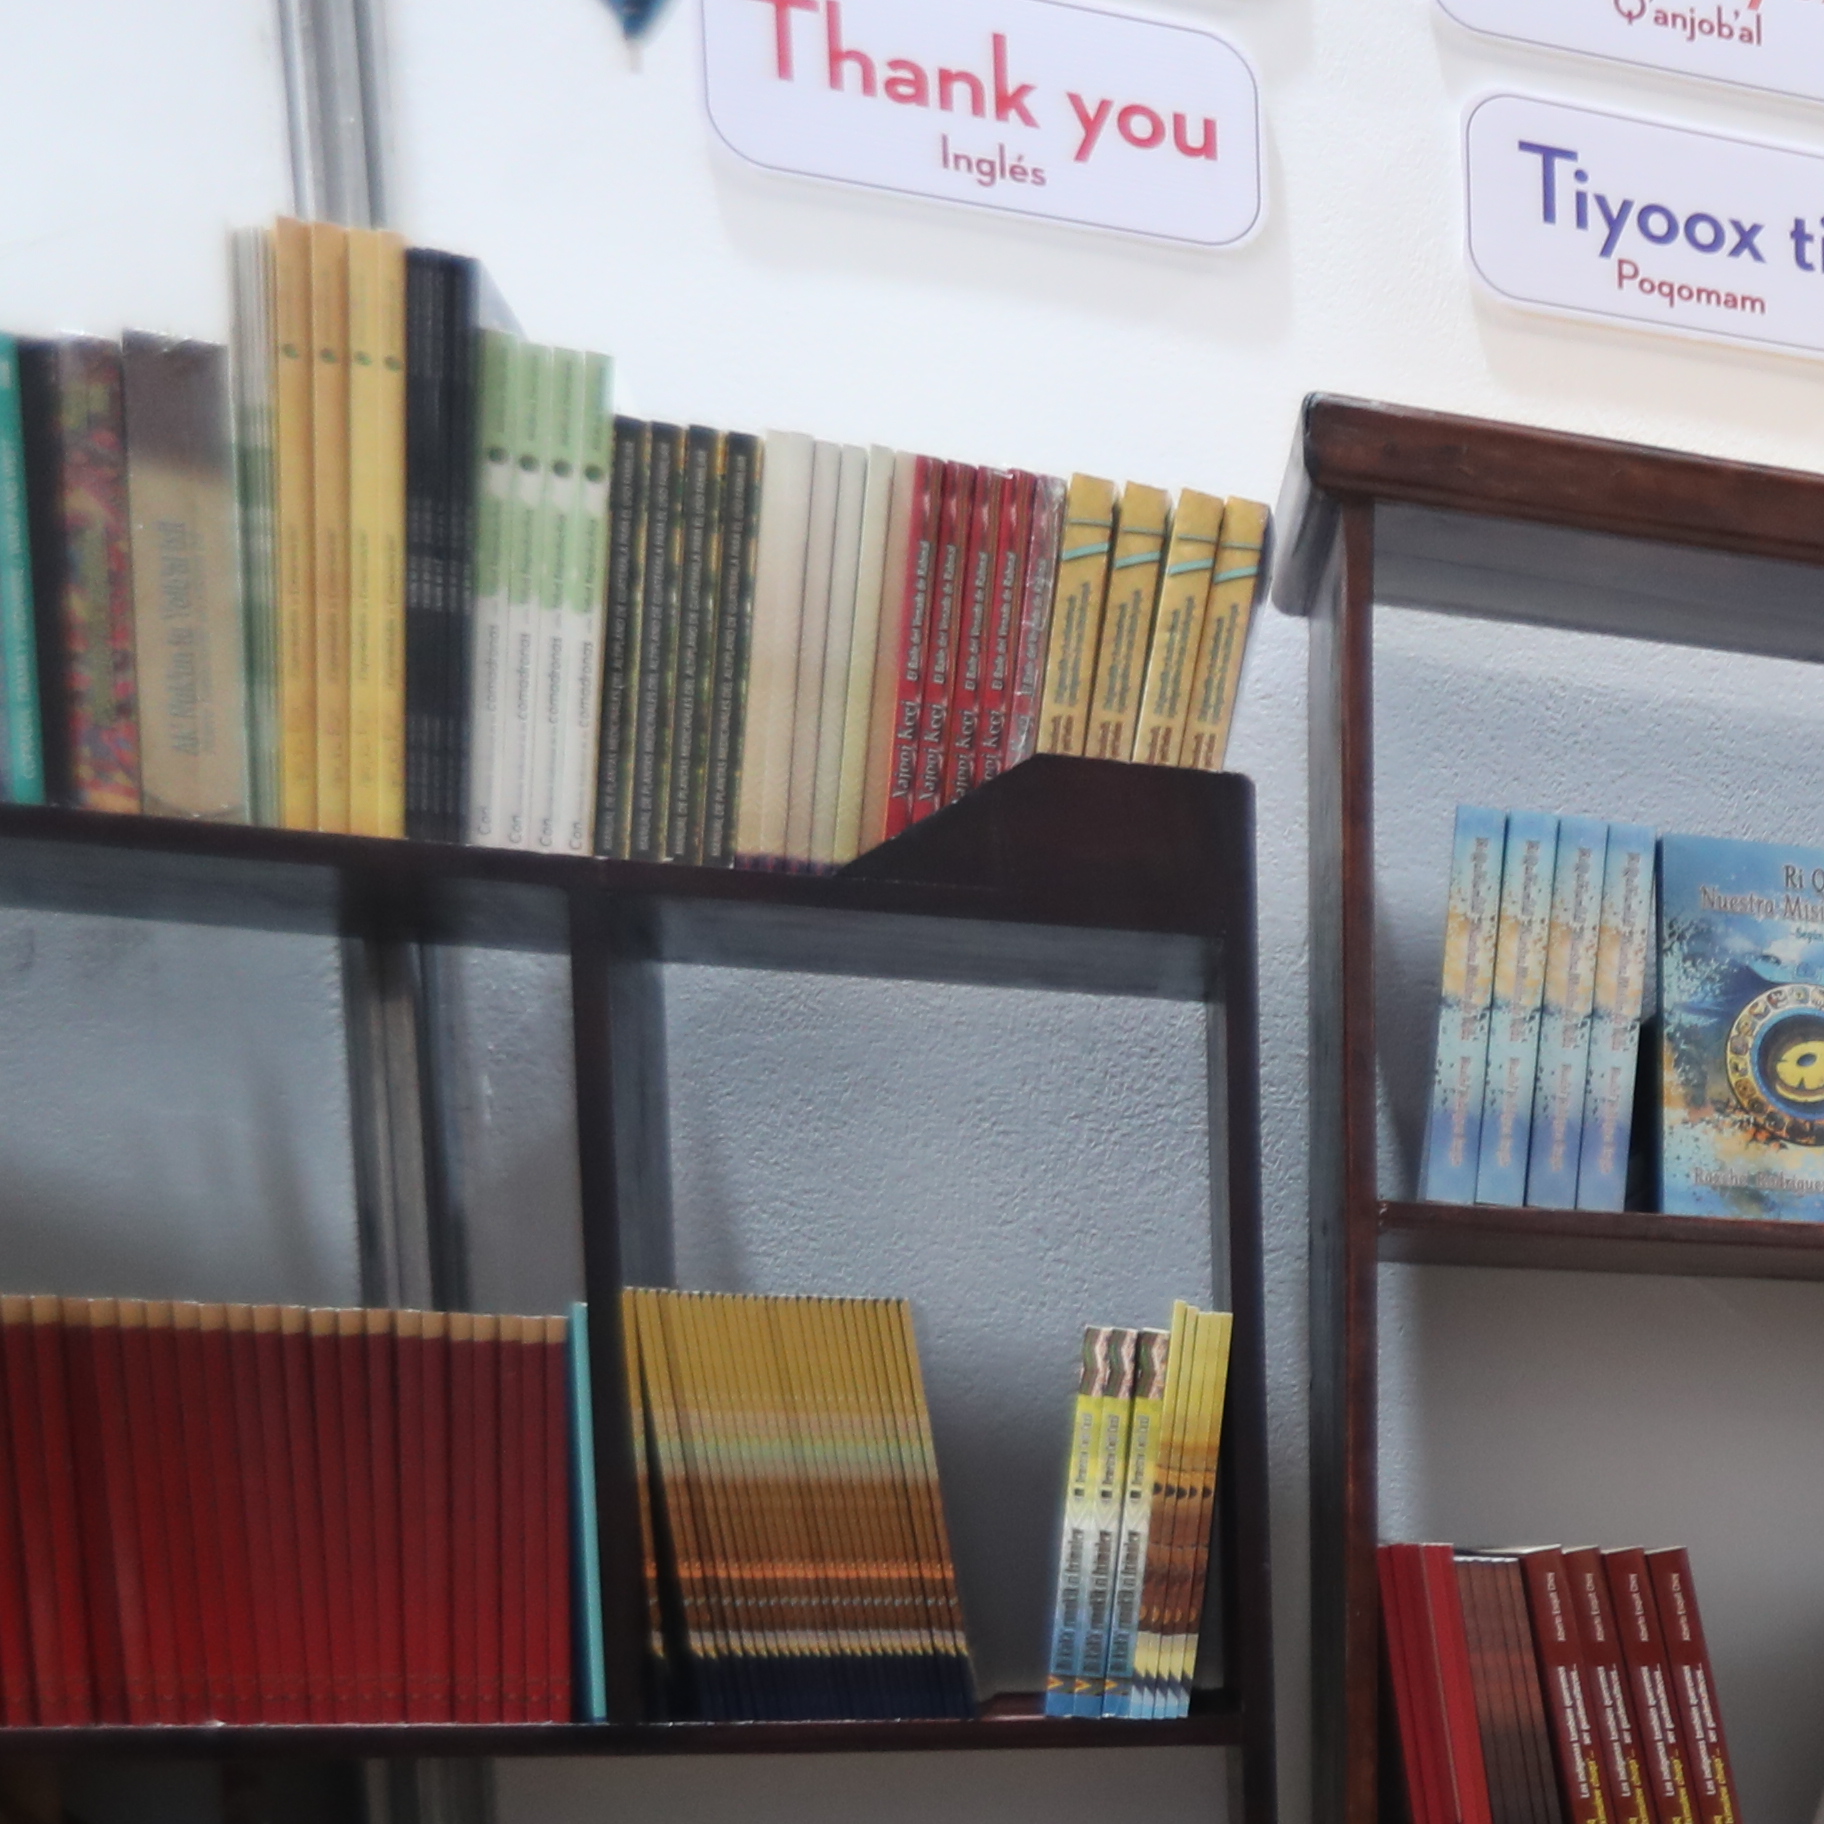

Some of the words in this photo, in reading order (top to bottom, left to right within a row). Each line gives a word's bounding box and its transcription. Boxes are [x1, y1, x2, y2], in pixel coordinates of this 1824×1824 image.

[762, 0, 1040, 129] Thank
[1066, 91, 1219, 162] you
[940, 134, 1048, 188] Inglés
[1518, 139, 1766, 263] Tiyoox
[1617, 258, 1766, 314] Poqomam
[1700, 885, 1776, 918] Nuestra
[1783, 863, 1804, 889] Ri
